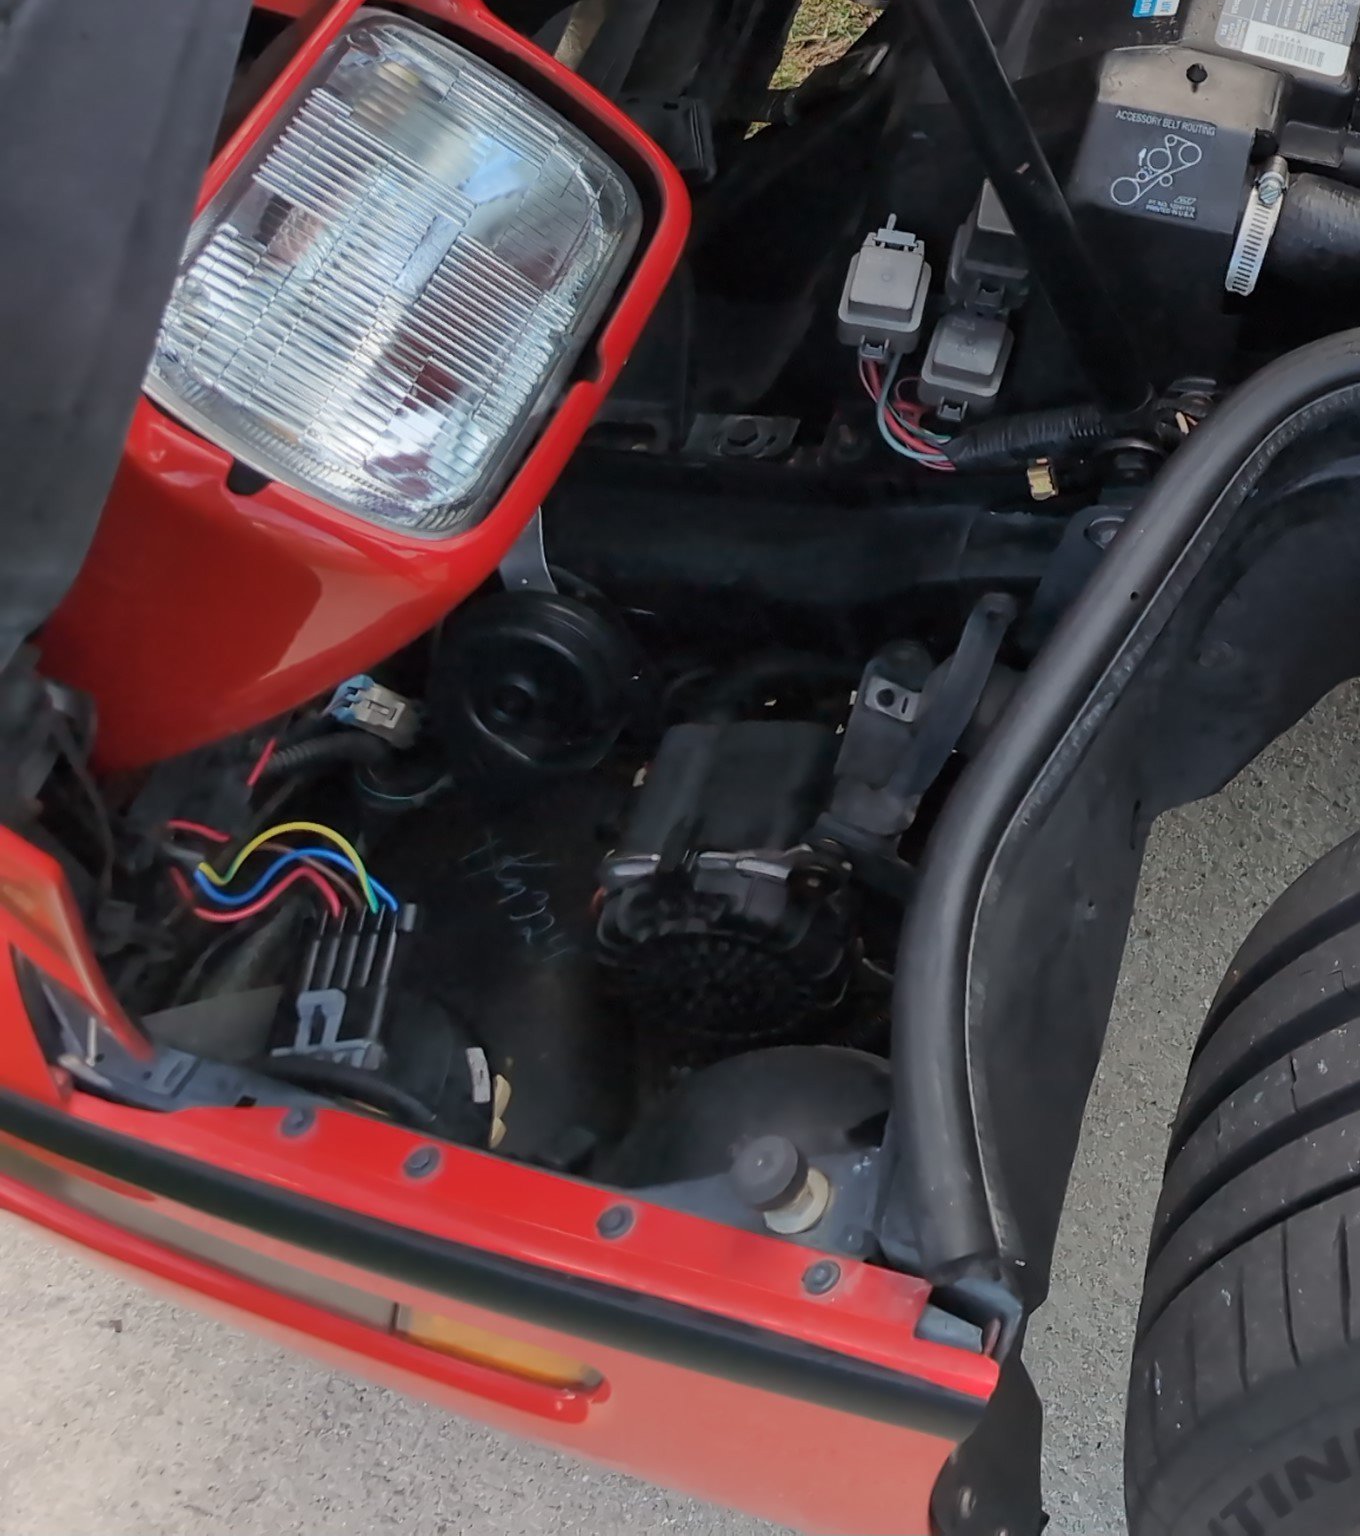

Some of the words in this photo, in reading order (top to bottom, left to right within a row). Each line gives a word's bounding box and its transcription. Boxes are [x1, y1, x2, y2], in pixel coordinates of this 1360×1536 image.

[1115, 110, 1160, 126] ACCESSORY
[1162, 119, 1180, 129] BELT
[1182, 122, 1215, 136] ROUTING
